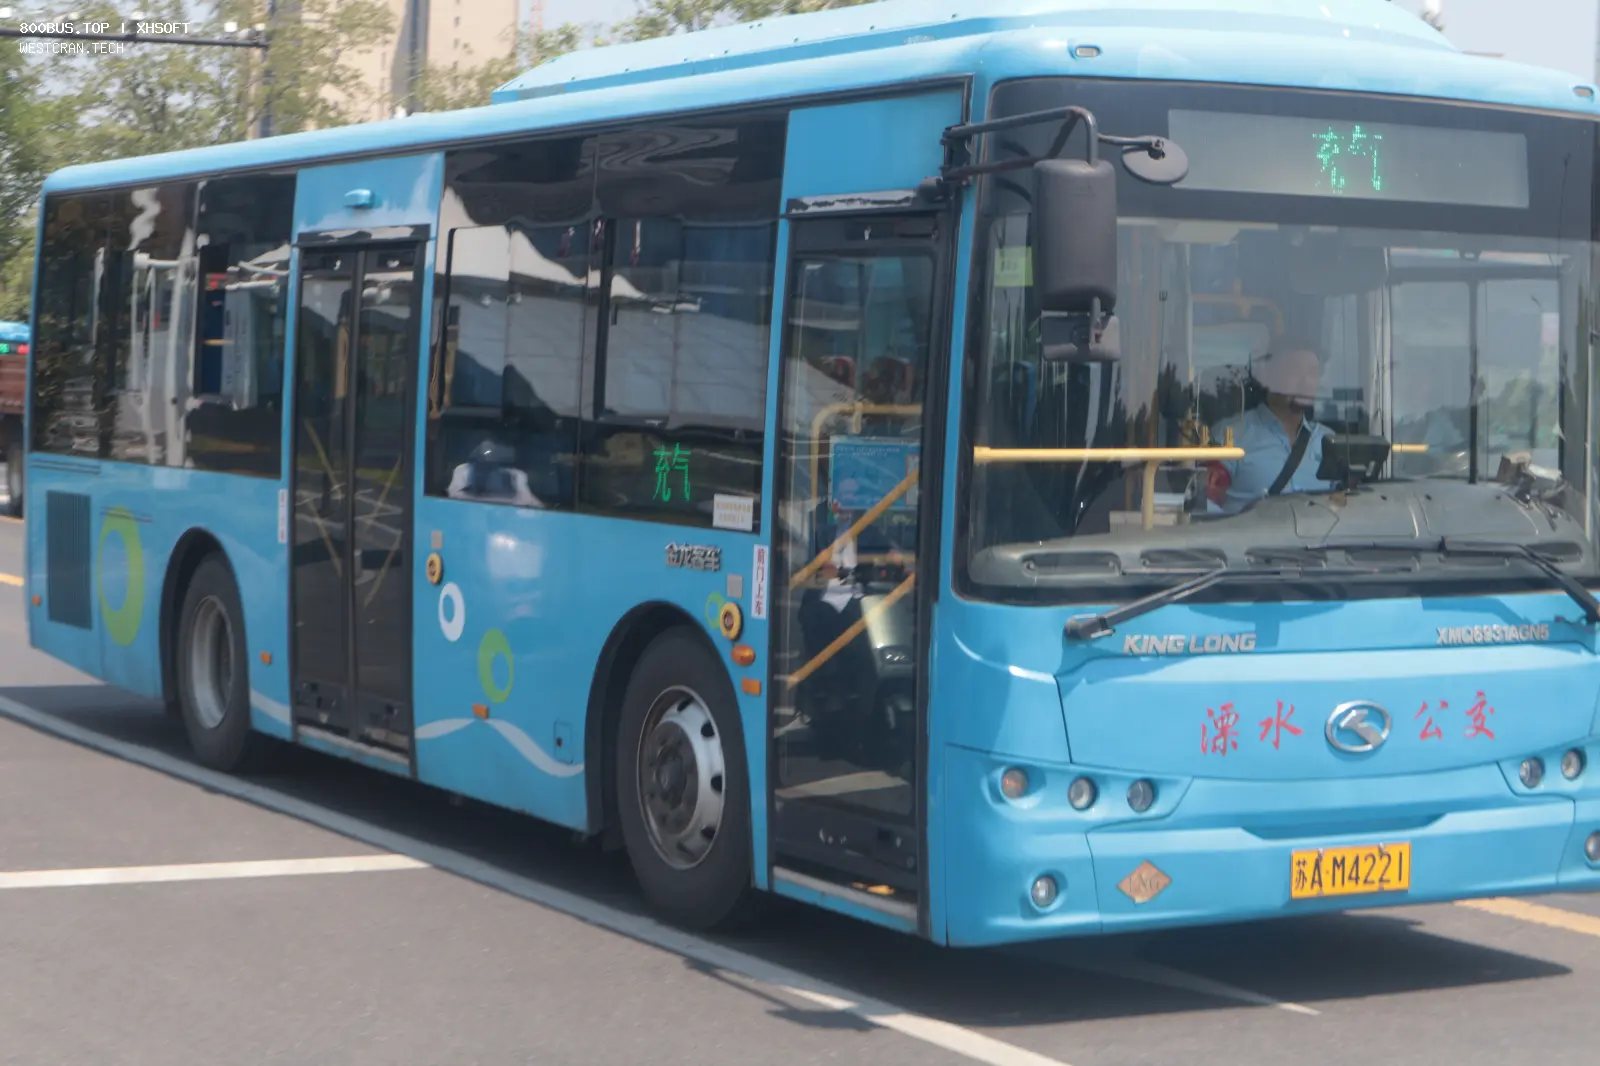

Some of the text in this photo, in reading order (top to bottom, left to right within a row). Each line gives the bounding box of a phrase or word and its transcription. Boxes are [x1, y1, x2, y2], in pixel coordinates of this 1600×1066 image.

[653, 442, 692, 502] 充气
[1123, 633, 1257, 656] KING LONG
[1413, 689, 1496, 742] 公交
